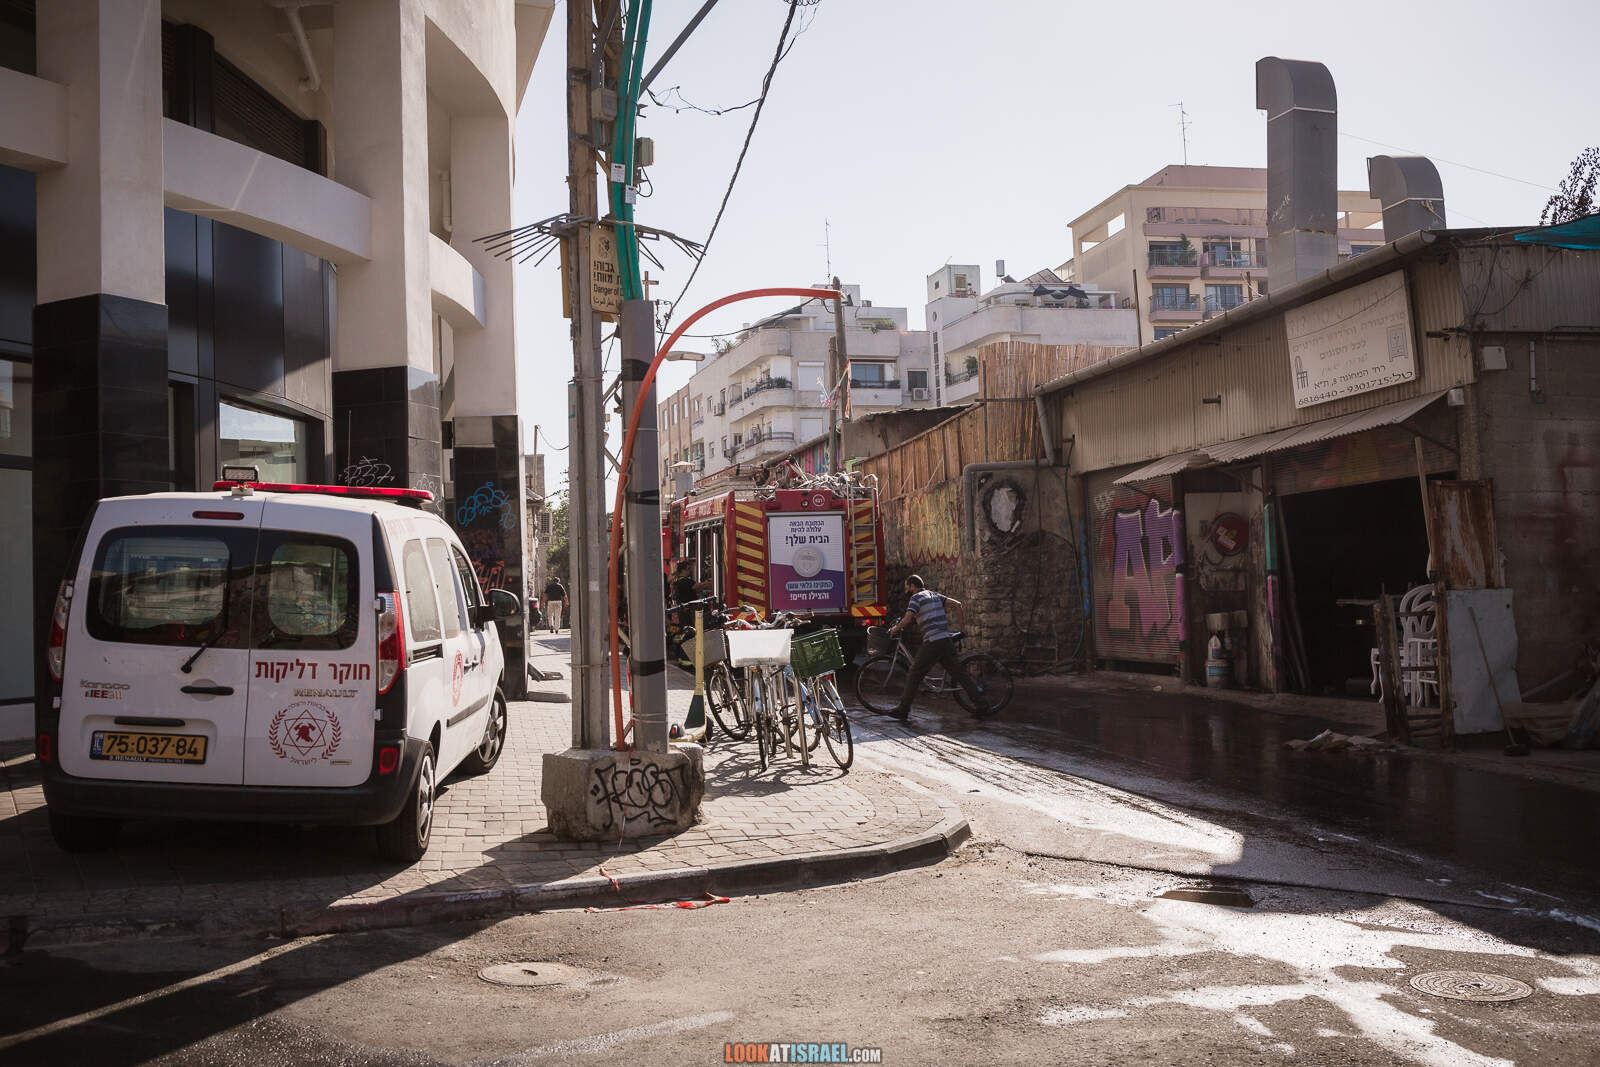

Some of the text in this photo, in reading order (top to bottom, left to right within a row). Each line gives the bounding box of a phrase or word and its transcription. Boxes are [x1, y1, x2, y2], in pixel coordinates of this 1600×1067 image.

[593, 260, 615, 273] גבוה!
[593, 283, 613, 296] Danger
[785, 534, 830, 547] הבית שלך!
[790, 591, 830, 601] והצילו חיים!
[255, 658, 371, 685] חוקר דליקות
